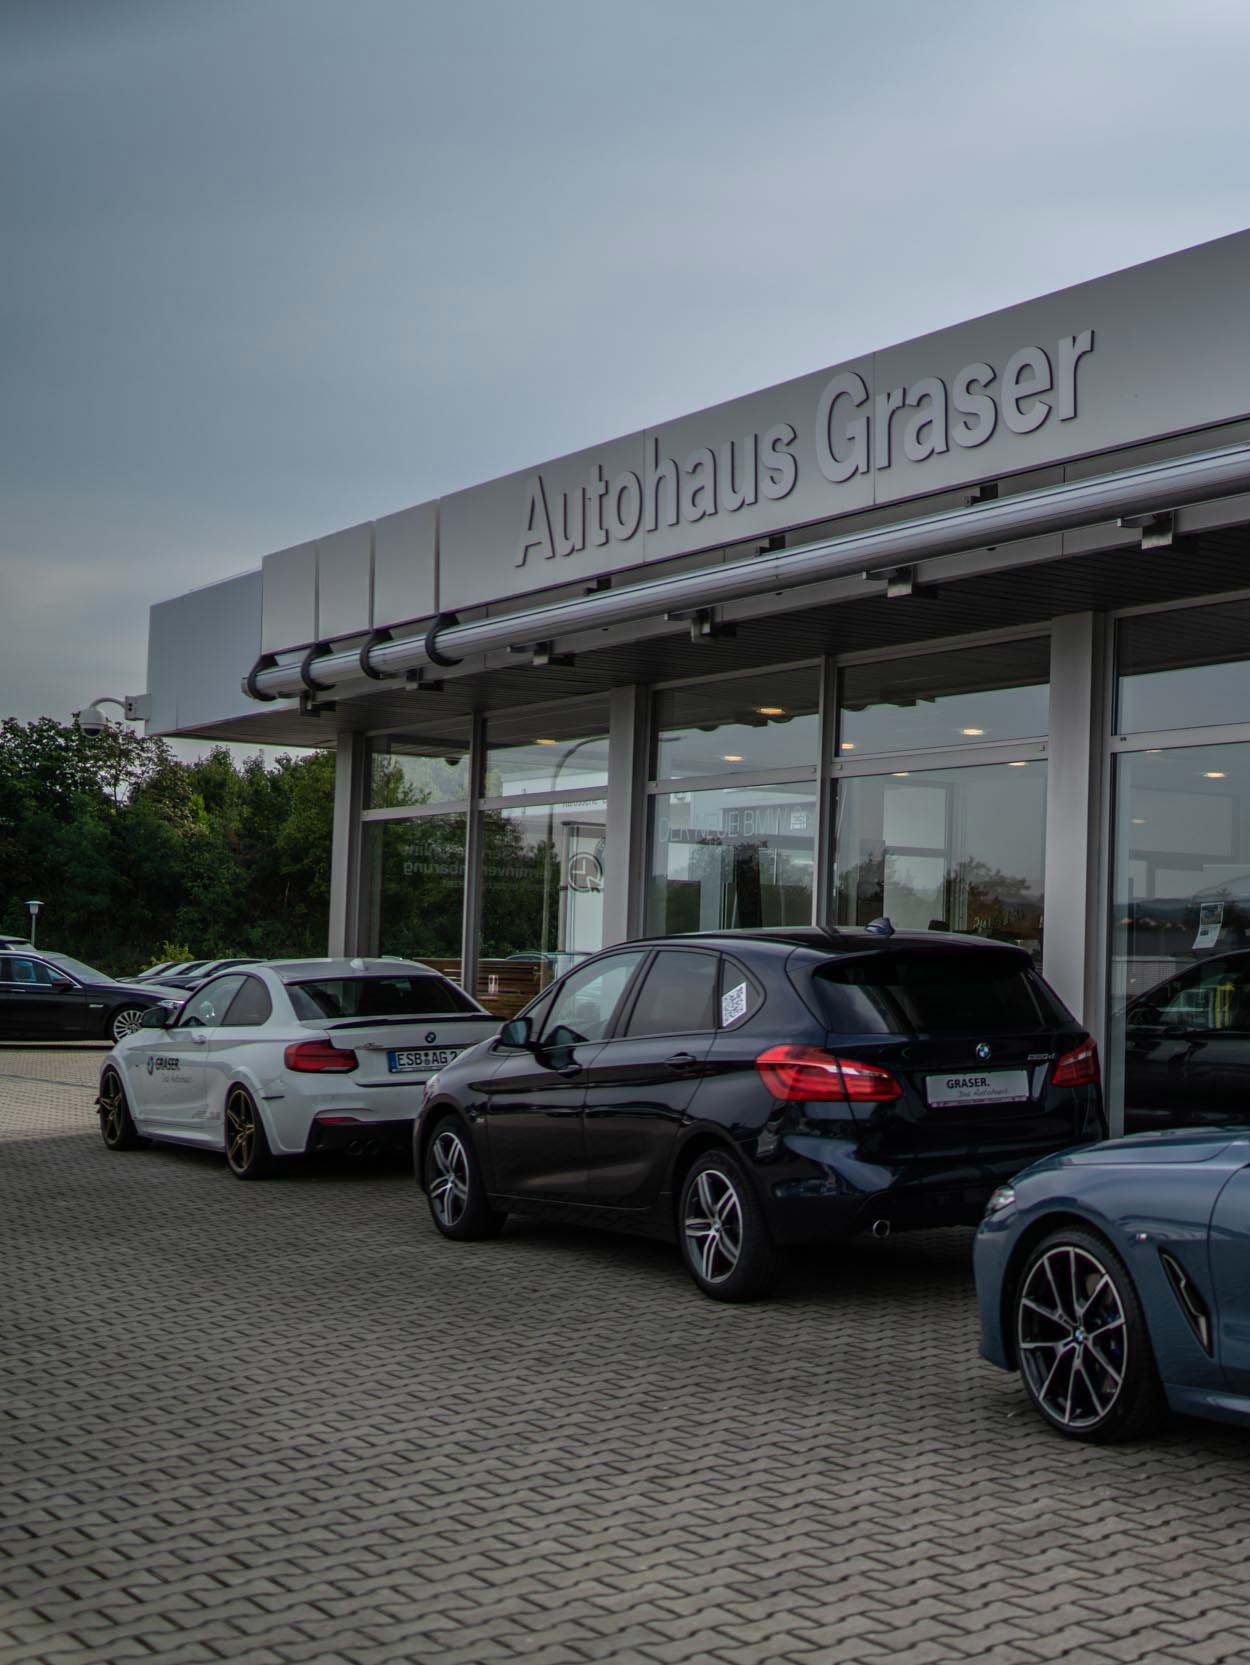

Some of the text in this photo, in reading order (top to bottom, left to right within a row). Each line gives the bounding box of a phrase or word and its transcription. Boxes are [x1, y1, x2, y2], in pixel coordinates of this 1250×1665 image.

[516, 329, 1096, 567] Autohaus Graser
[743, 807, 787, 836] BMW
[397, 1050, 464, 1066] ESB AG 2
[946, 1077, 990, 1089] GRASER.
